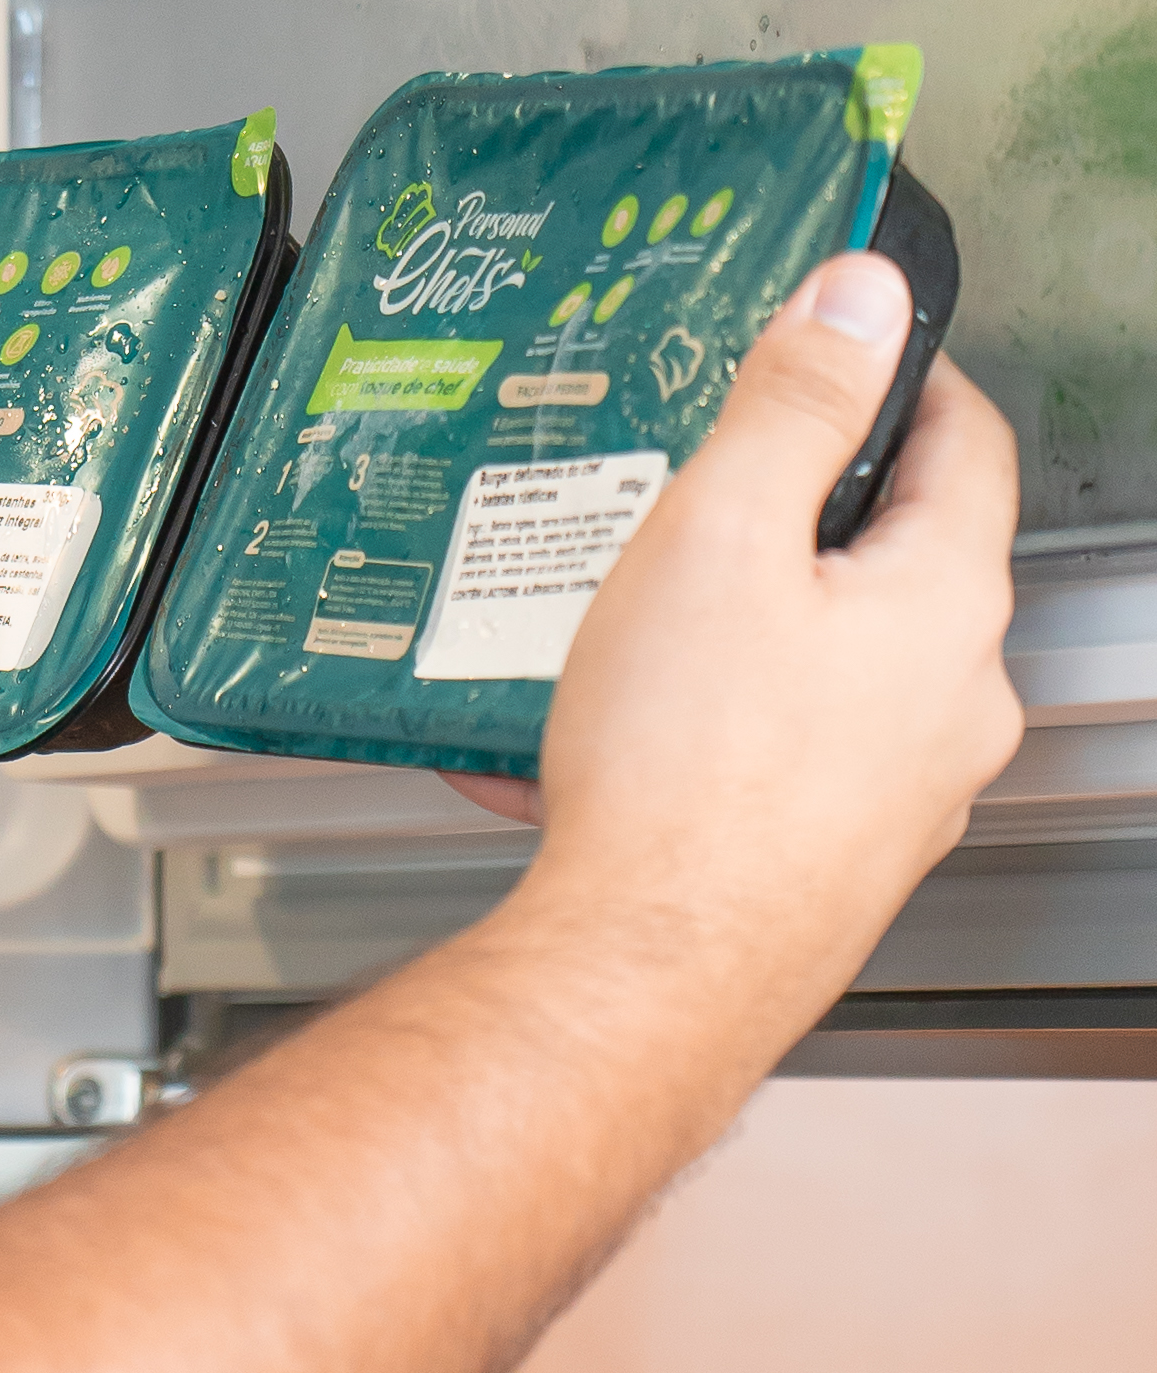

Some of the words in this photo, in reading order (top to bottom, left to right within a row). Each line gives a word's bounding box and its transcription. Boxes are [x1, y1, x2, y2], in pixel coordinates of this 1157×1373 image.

[453, 190, 556, 240] Personal
[339, 356, 419, 376] Praticidade
[432, 356, 480, 373] saúde
[330, 382, 359, 398] com
[359, 379, 402, 396] toque
[403, 378, 422, 394] de
[424, 378, 465, 396] chef
[274, 460, 293, 495] 1
[348, 453, 370, 491] 3
[244, 519, 270, 555] 2
